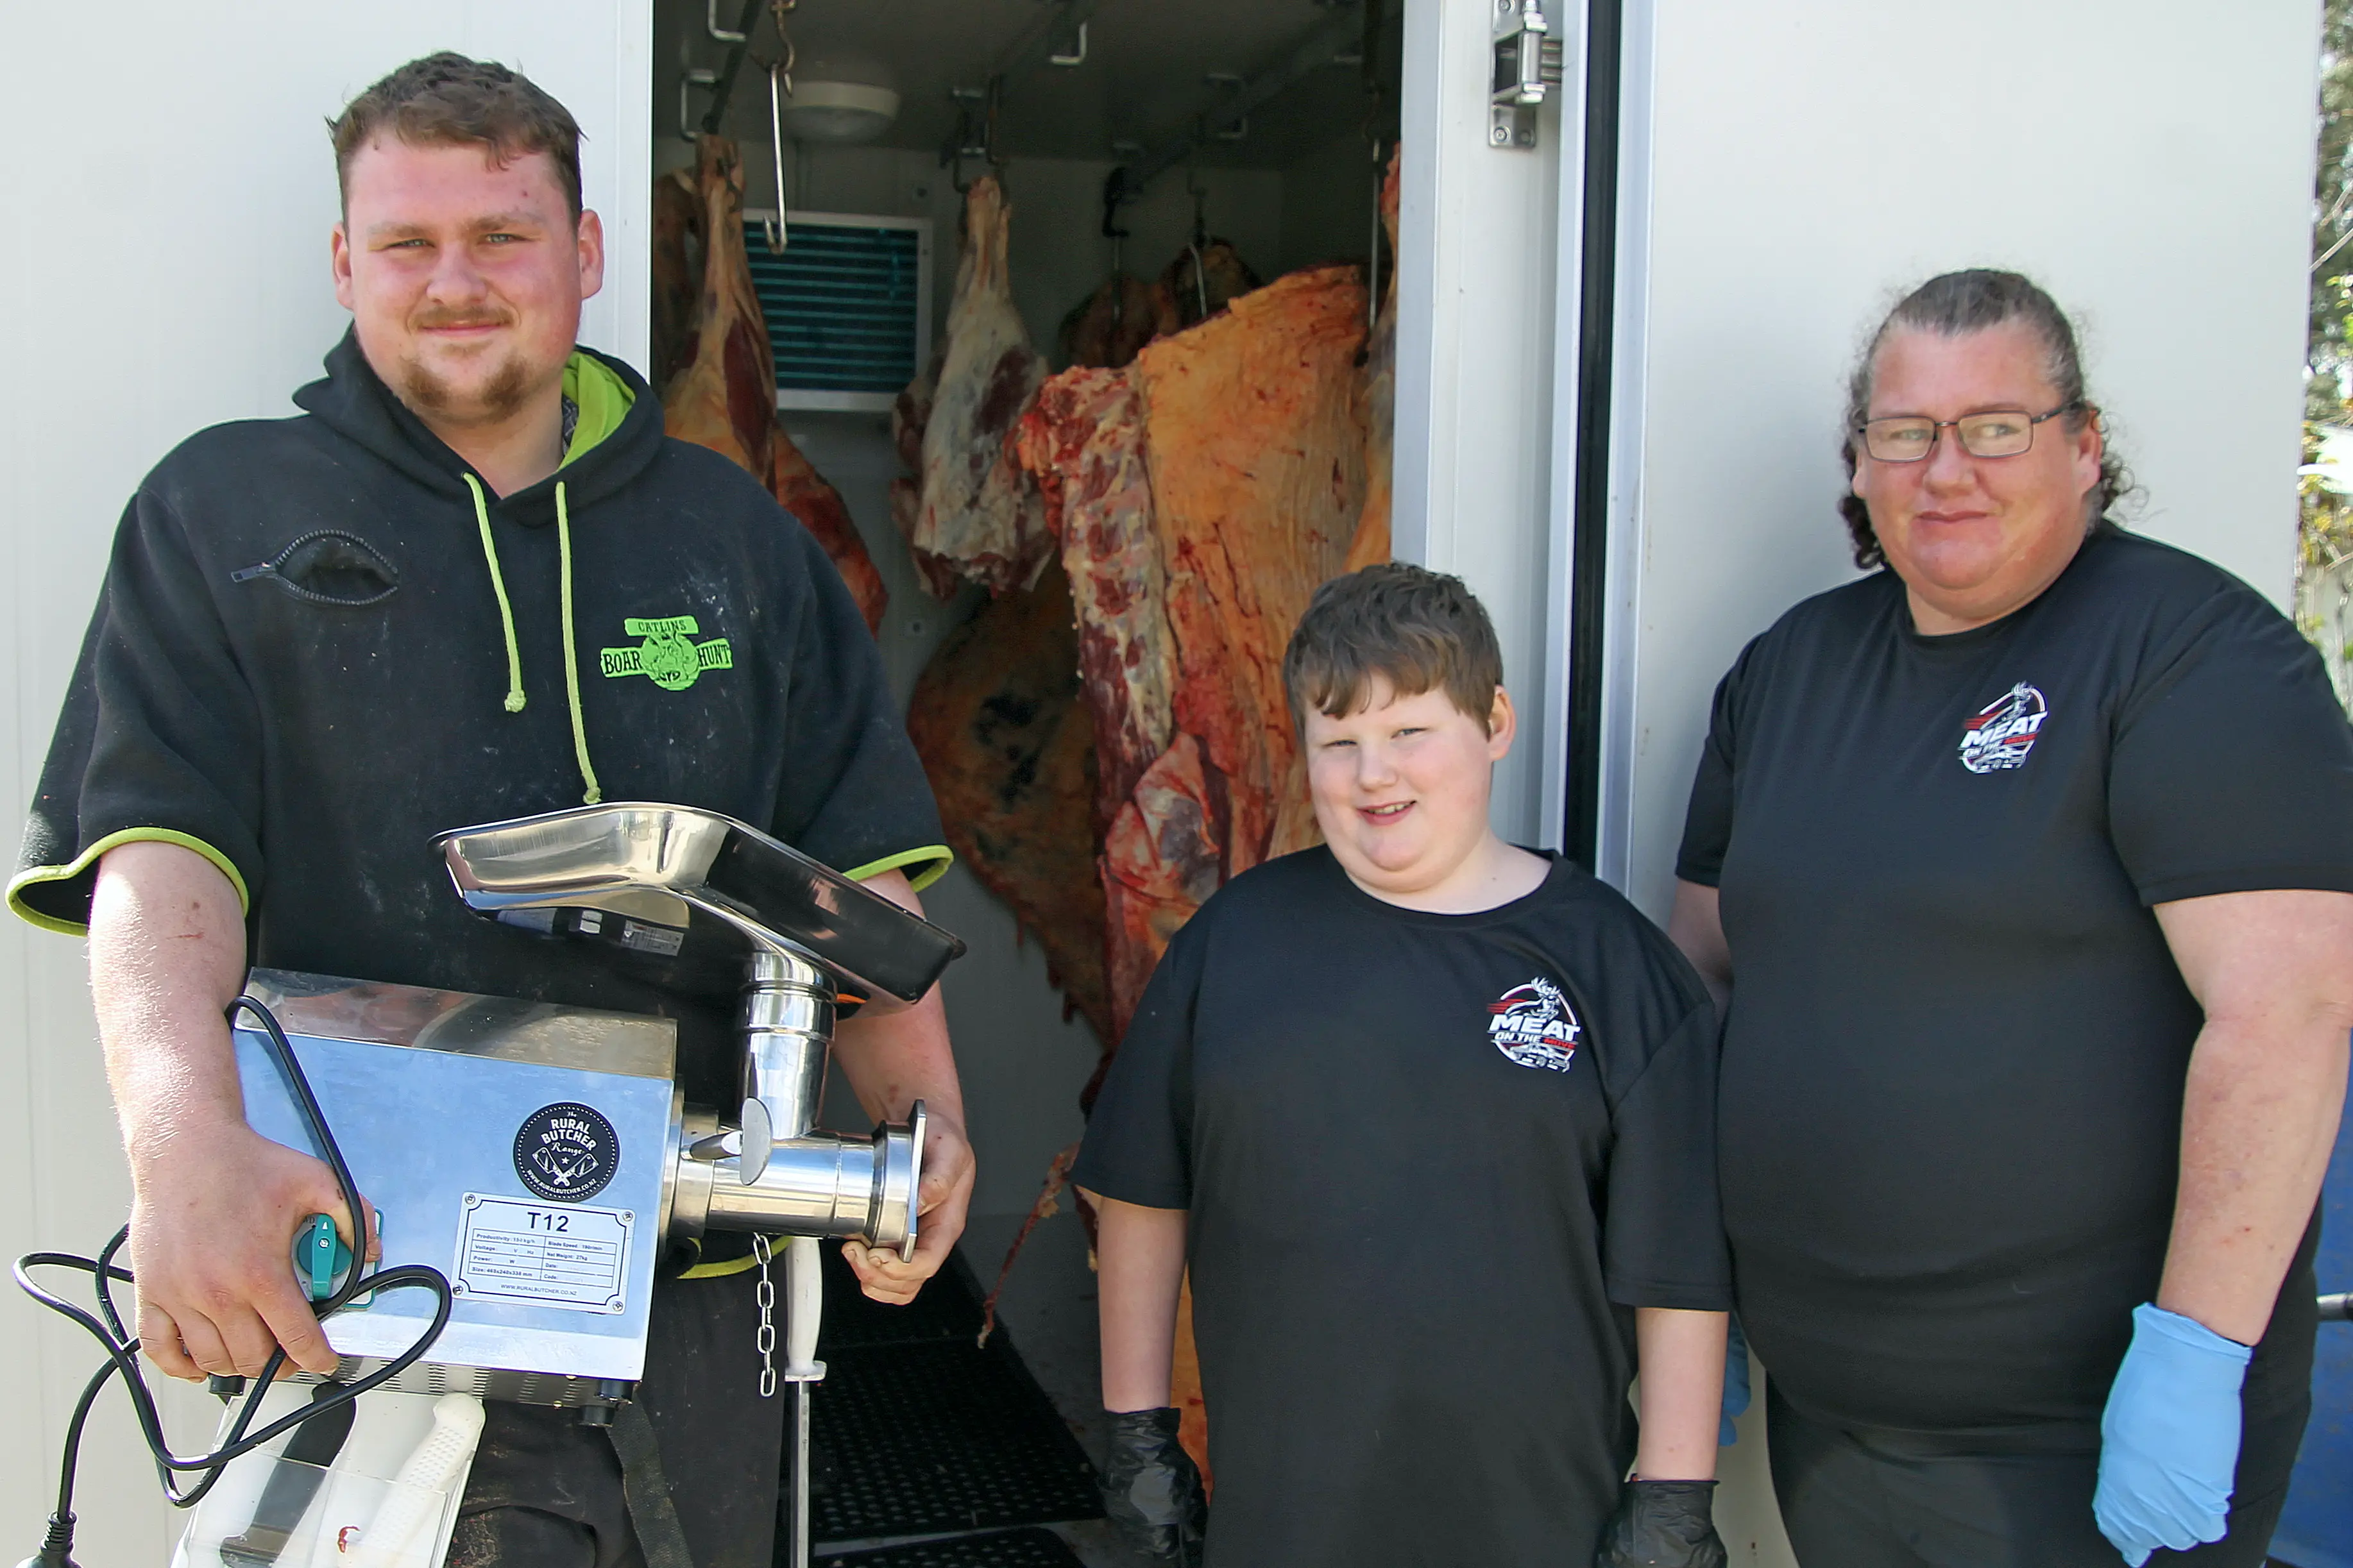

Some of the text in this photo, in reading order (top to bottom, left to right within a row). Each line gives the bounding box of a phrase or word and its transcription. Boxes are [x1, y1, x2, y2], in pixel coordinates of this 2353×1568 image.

[638, 620, 686, 632] CATLINS
[603, 644, 730, 674] BOAR HUNT
[1960, 711, 2048, 747] MEAT
[1489, 1014, 1581, 1041] MEAT
[1494, 1031, 1515, 1040] ON
[1516, 1033, 1543, 1043] THE
[551, 1118, 590, 1134] RURAL
[541, 1129, 597, 1151] BUTCHER
[551, 1142, 585, 1156] Range
[527, 1211, 570, 1233] T12
[500, 1284, 577, 1296] WWW.RURALBUTCHER.CO.NZ
